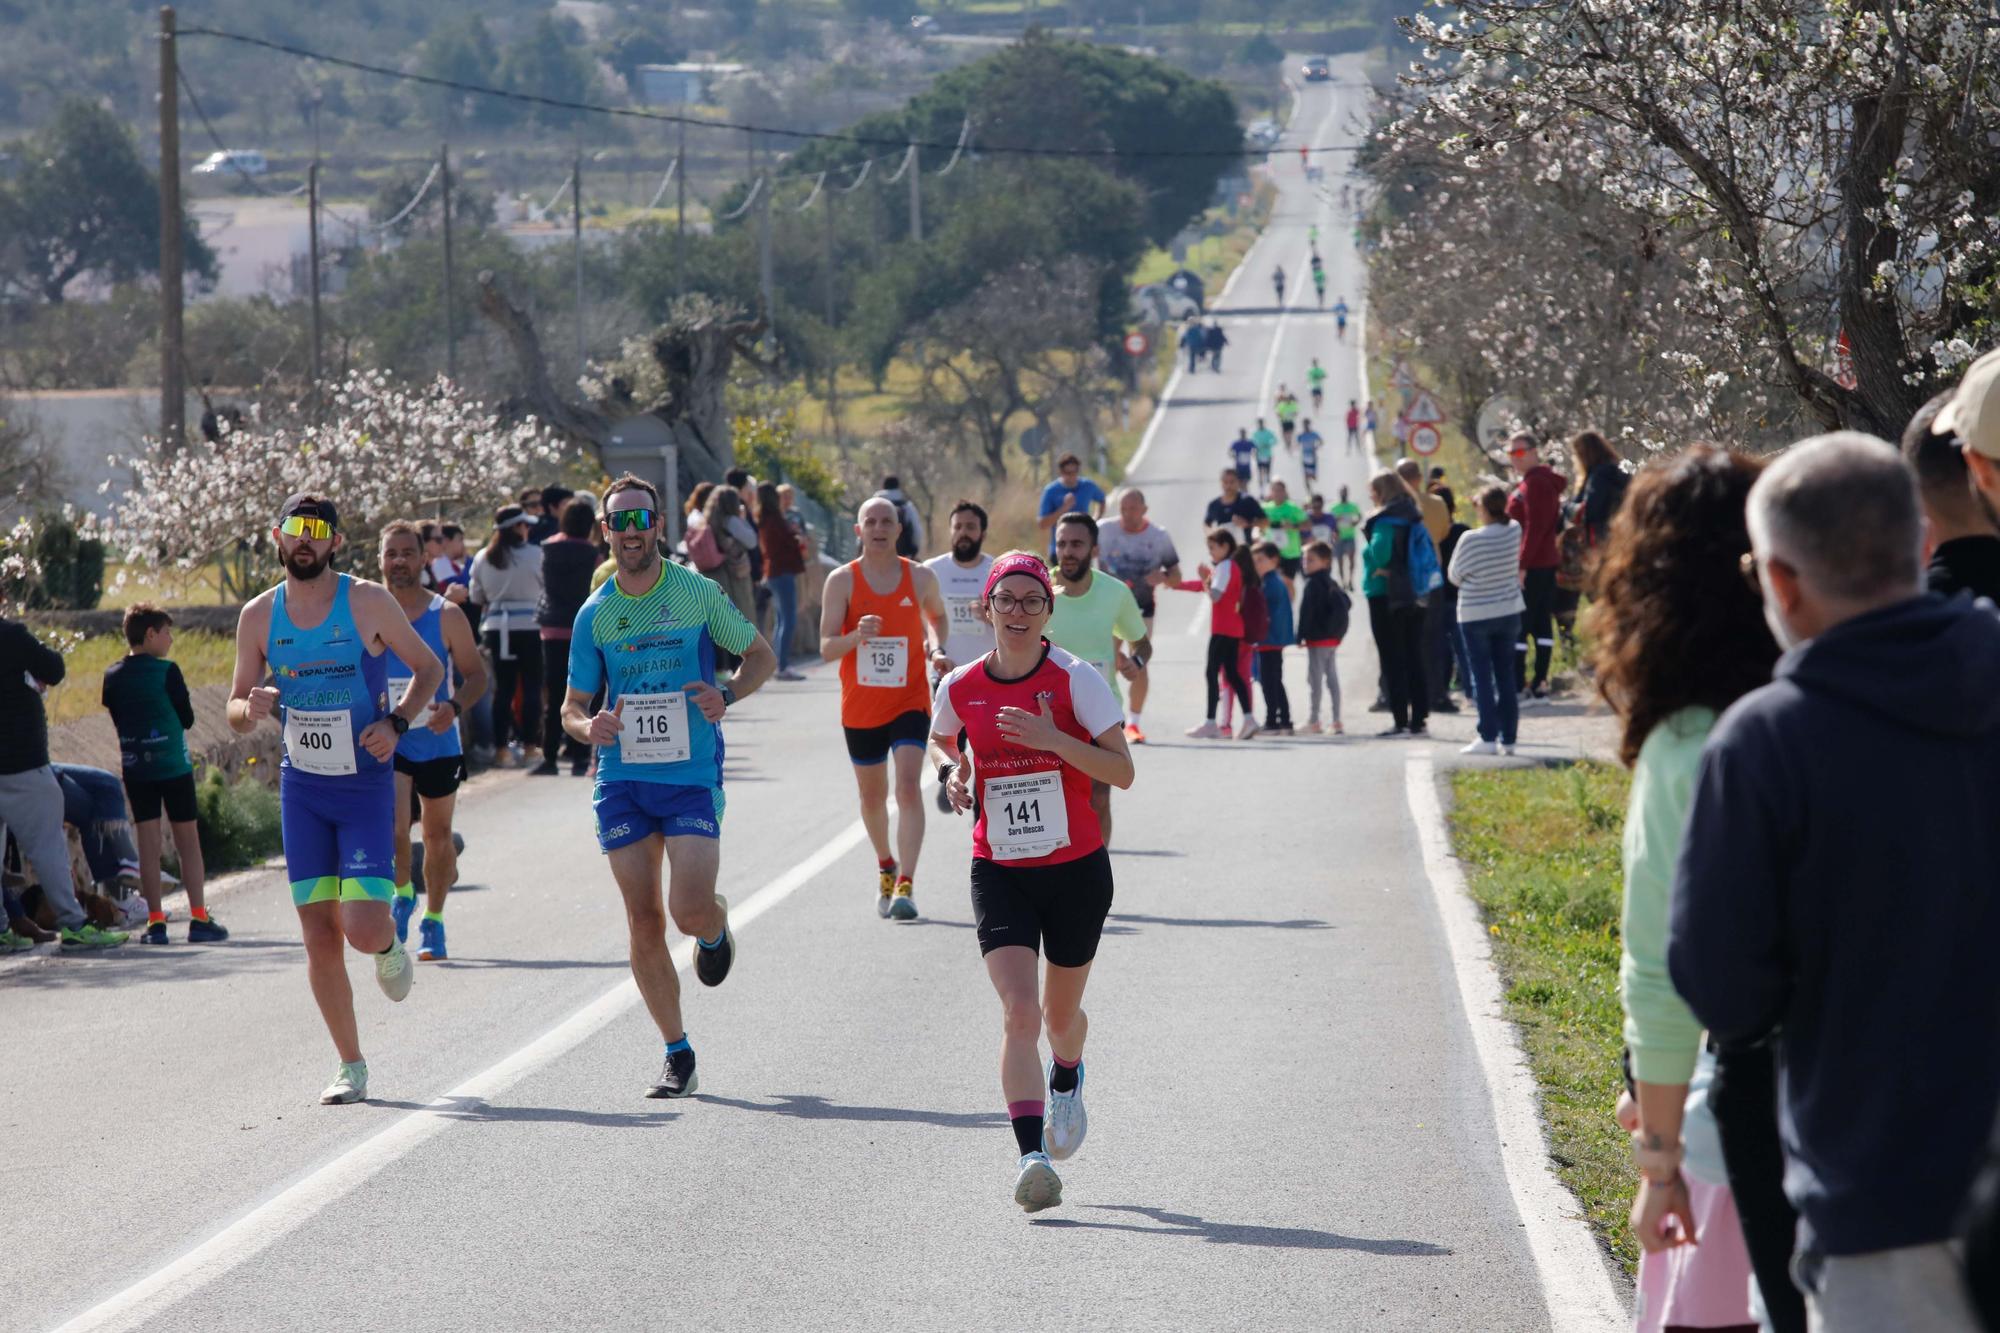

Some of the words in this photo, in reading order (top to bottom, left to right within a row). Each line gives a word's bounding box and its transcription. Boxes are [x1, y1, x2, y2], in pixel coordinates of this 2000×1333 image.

[953, 606, 972, 618] 151
[871, 652, 895, 667] 136
[636, 715, 668, 734] 116
[300, 731, 332, 750] 400
[1004, 799, 1041, 825] 141
[1008, 827, 1022, 836] Sara
